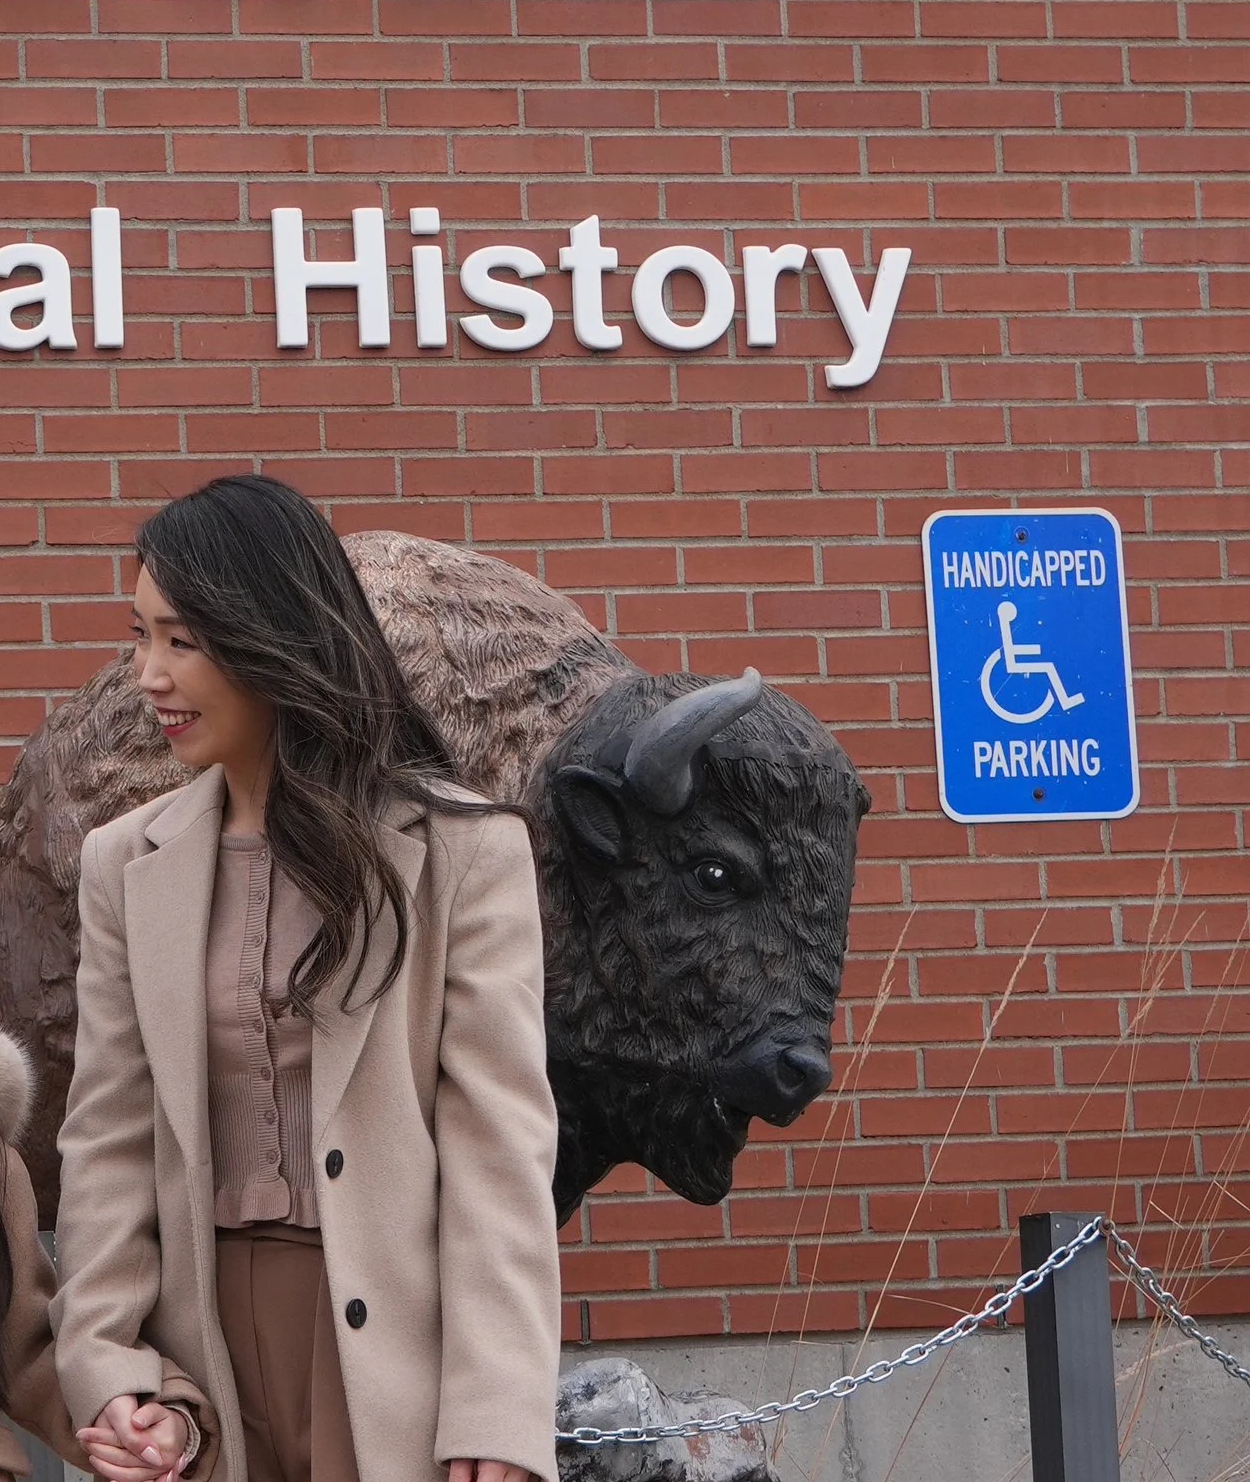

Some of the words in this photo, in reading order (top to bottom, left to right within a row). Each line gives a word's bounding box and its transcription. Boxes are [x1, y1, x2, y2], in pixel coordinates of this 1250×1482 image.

[270, 206, 913, 390] History
[941, 549, 1107, 589] HANDICAPPED
[973, 738, 1101, 779] PARKING
